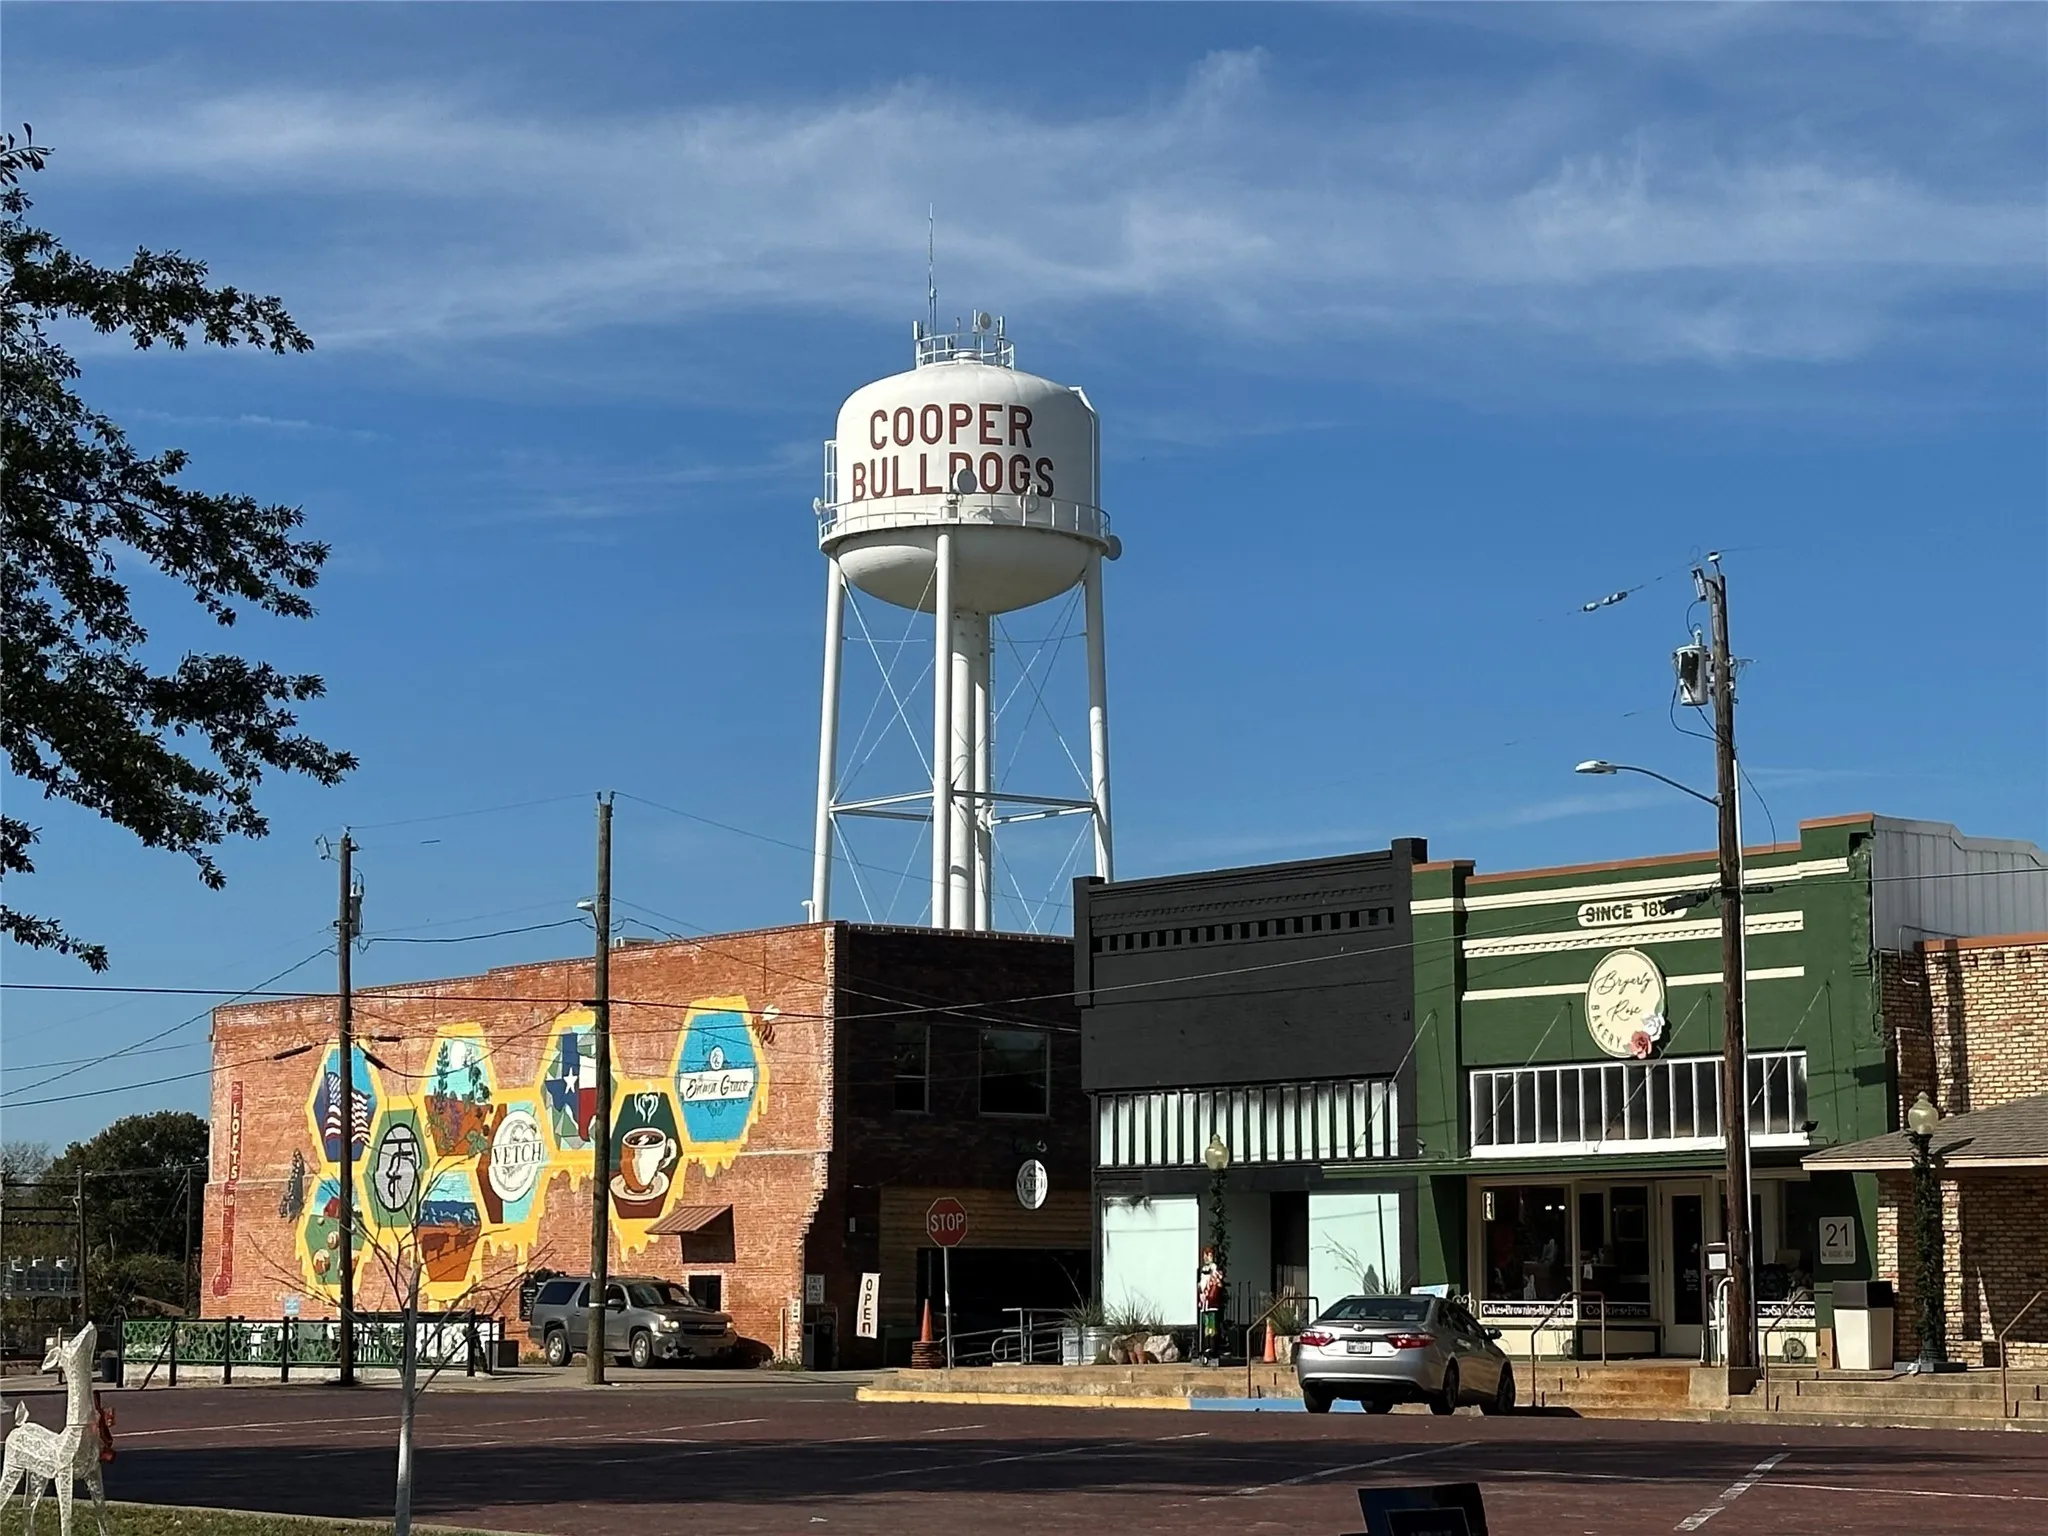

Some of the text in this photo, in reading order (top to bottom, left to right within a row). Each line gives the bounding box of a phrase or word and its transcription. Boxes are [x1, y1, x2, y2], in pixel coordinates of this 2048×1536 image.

[870, 403, 1033, 450] COOPER
[1585, 899, 1676, 922] SINCE 188
[1606, 999, 1642, 1022] Rose
[1591, 1004, 1622, 1048] BAKERY
[720, 1074, 749, 1096] Grace
[231, 1102, 240, 1180] LOFTS
[493, 1142, 542, 1165] VETCH
[930, 1213, 964, 1232] STOP
[1825, 1223, 1848, 1247] 21
[1586, 1304, 1625, 1316] Cokies
